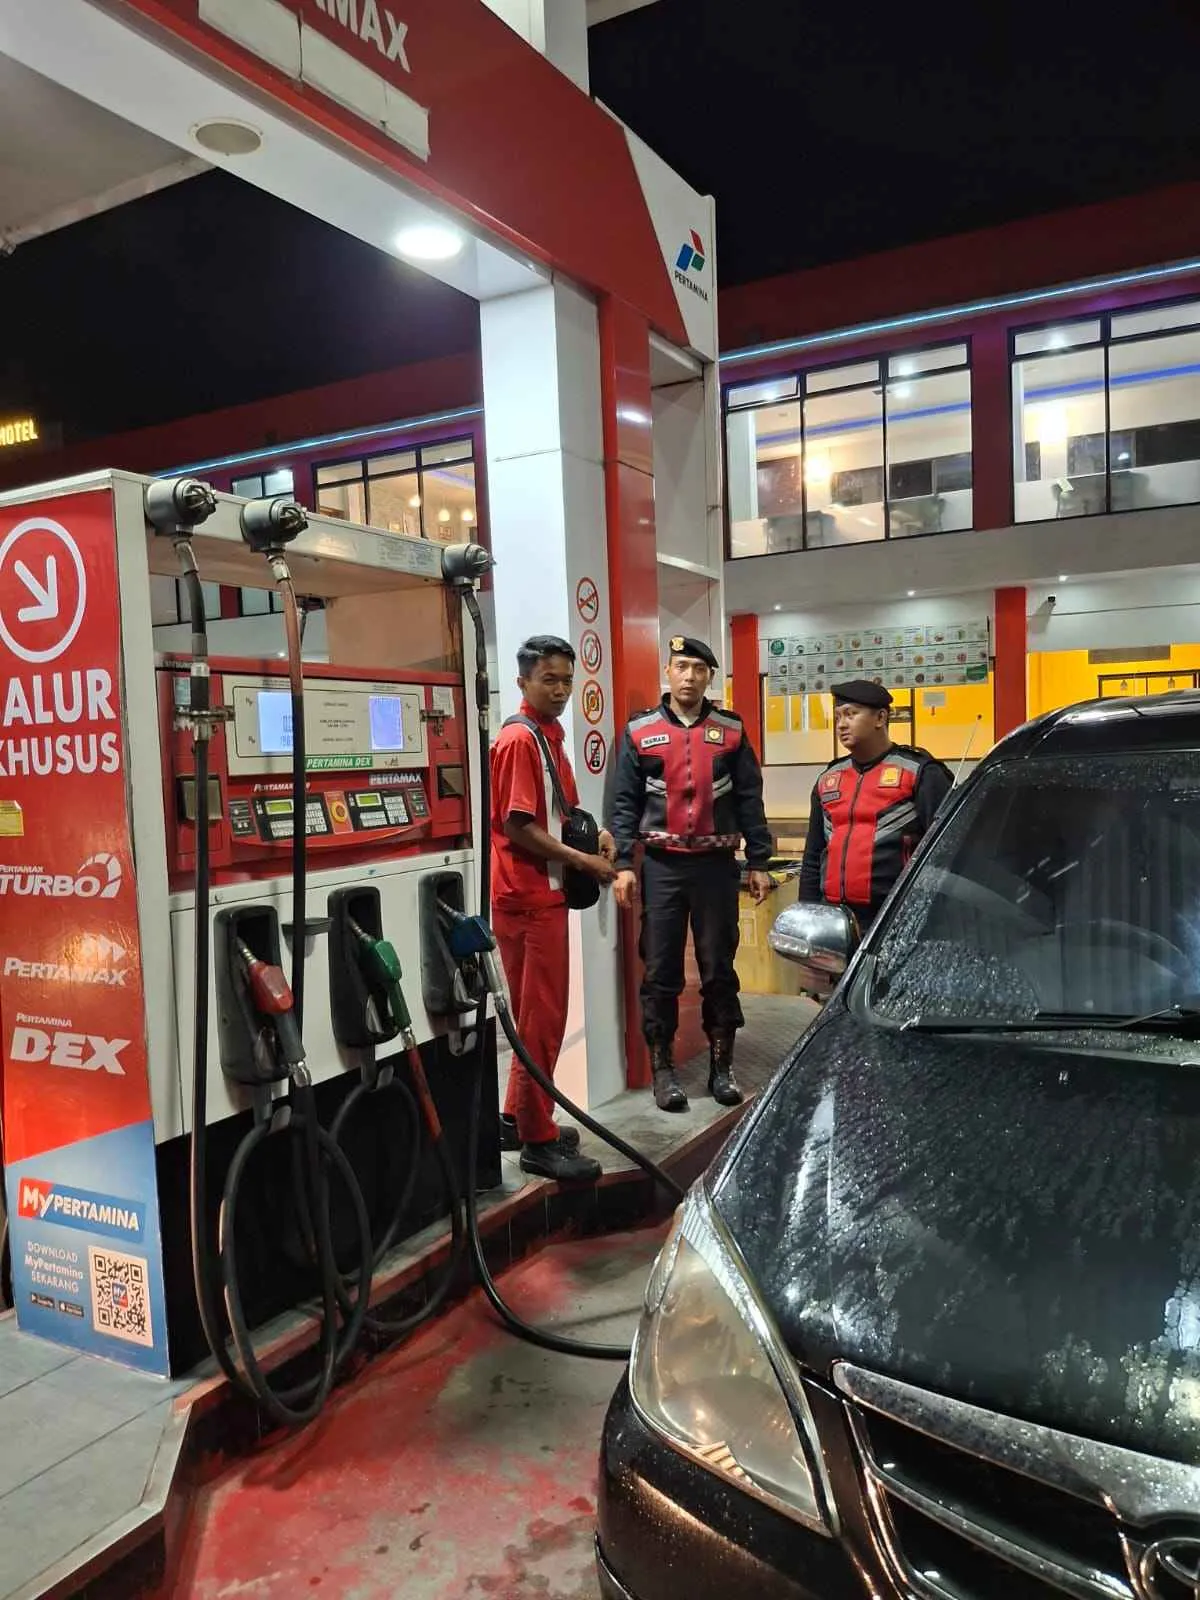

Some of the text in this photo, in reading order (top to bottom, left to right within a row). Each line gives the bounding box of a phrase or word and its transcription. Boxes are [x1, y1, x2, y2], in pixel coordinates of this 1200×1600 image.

[316, 0, 411, 73] MAX
[674, 269, 709, 302] PERTAMINA
[3, 668, 117, 727] ALUR
[306, 756, 372, 769] PERTAMINA DEX
[370, 773, 422, 785] PERTAMAX
[4, 957, 128, 986] PERTAMAX
[16, 1012, 73, 1028] PERTAMINA
[10, 1026, 132, 1076] DEX
[27, 1240, 78, 1262] DOWNLOAD
[25, 1255, 83, 1280] MyPertamina
[31, 1270, 79, 1293] SEKARANG
